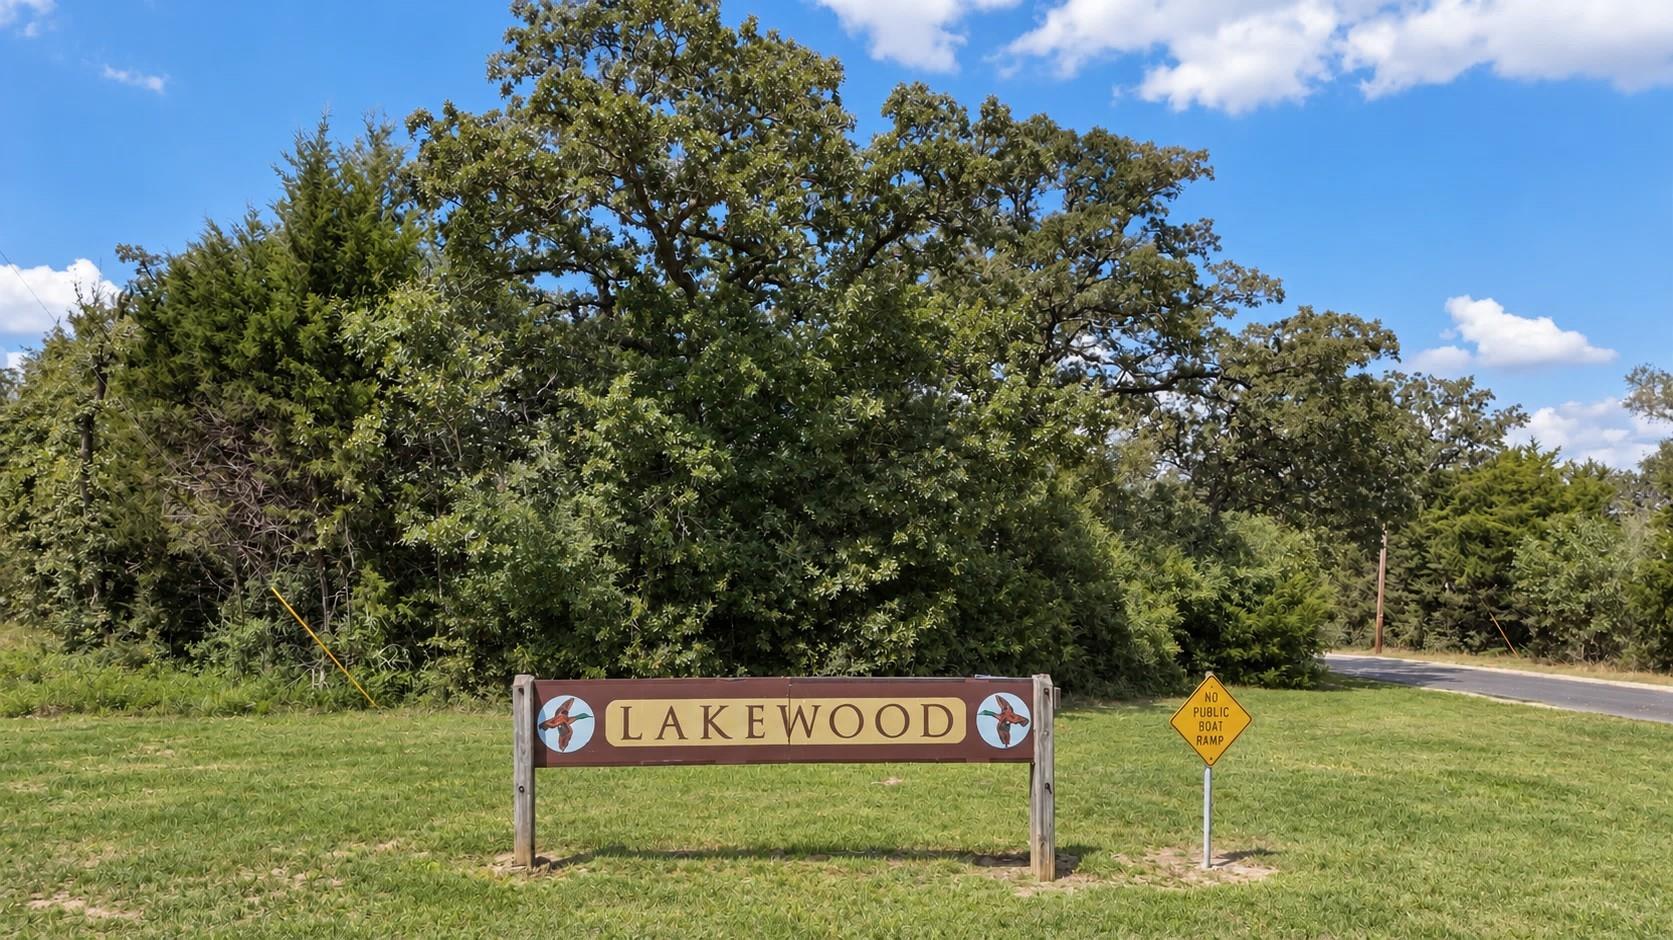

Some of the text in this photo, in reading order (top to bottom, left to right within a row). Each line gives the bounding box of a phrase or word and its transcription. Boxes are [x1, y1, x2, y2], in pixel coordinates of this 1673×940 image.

[1204, 691, 1218, 703] NO
[1193, 706, 1230, 718] PUBLIC
[620, 703, 954, 740] LAKEWOOD
[1198, 720, 1224, 732] BOAT
[1196, 735, 1224, 746] RAMP
